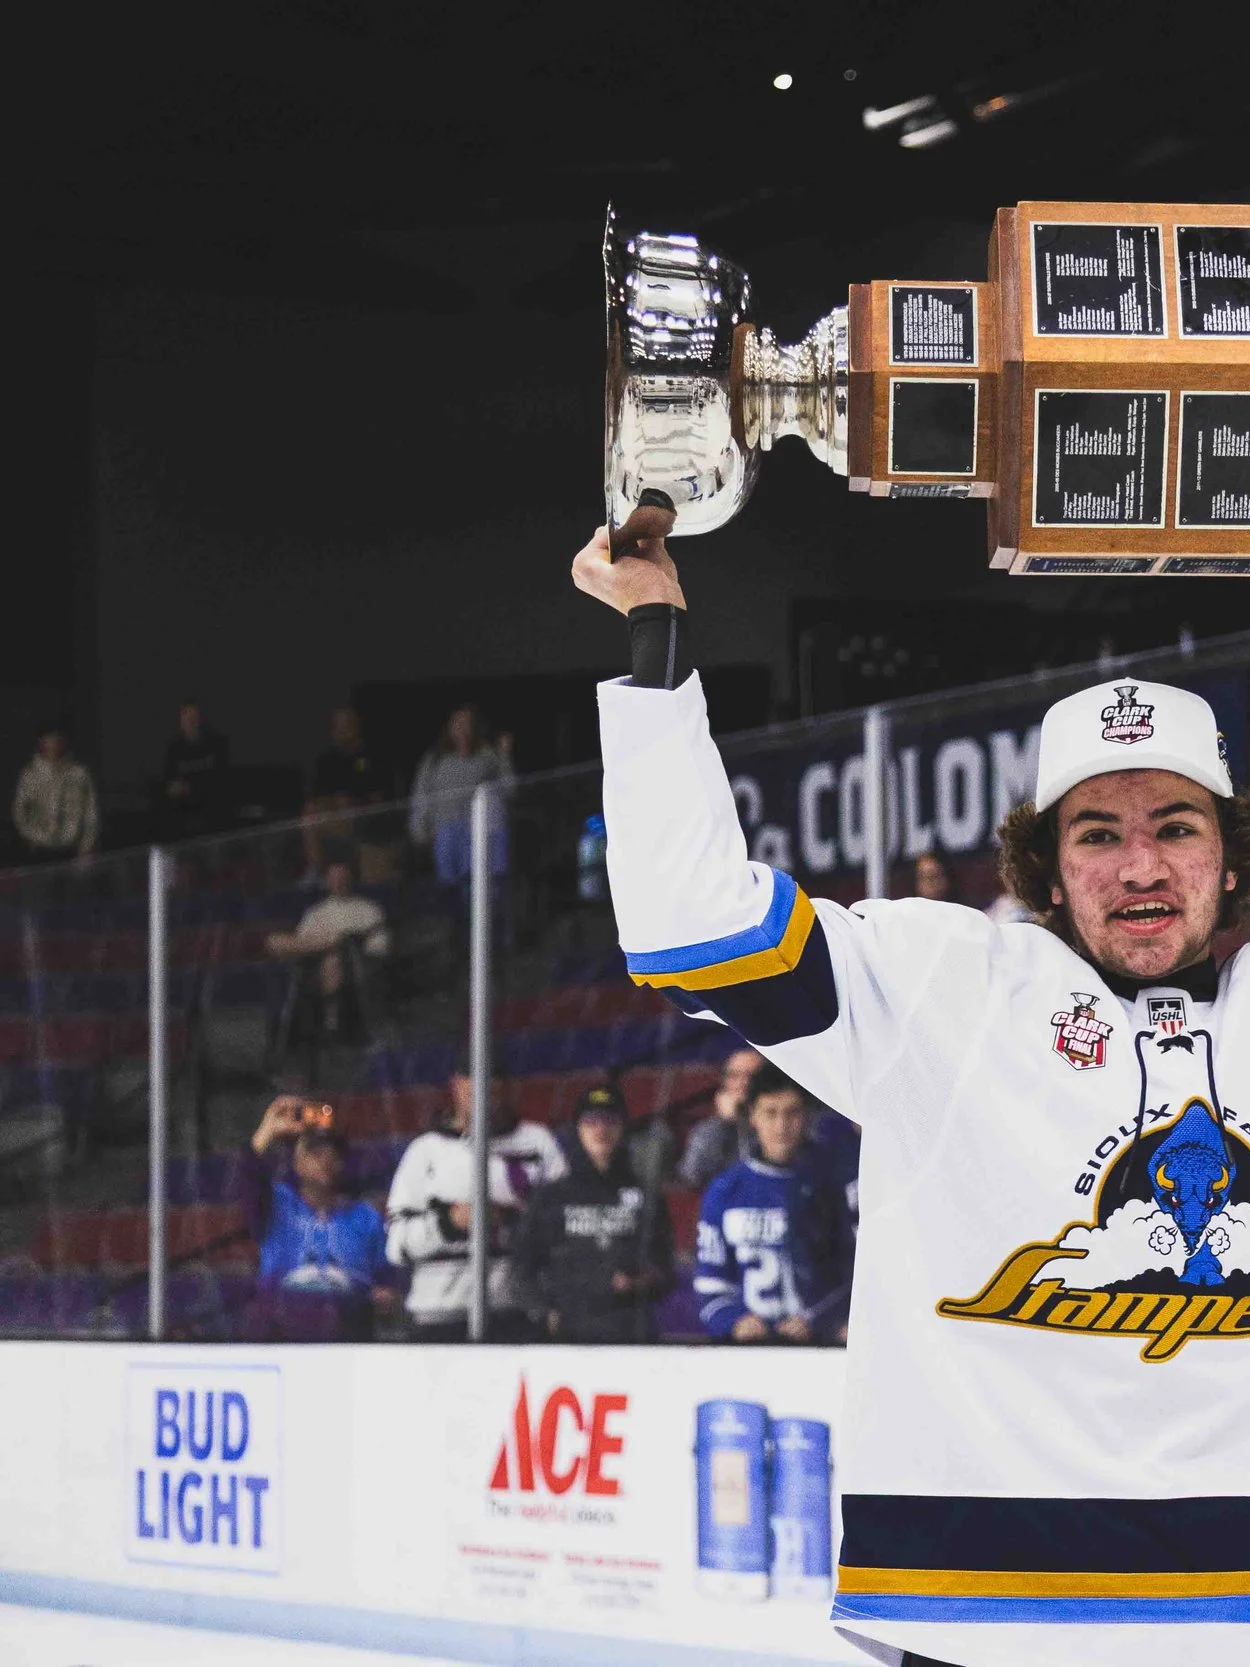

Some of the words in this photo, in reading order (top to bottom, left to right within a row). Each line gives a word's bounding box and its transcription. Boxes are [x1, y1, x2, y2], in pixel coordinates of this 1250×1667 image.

[1103, 706, 1151, 719] CLARK
[1112, 715, 1142, 727] CUP
[1103, 725, 1152, 738] CHAMPIONS
[1051, 1011, 1113, 1037] CLARK
[1152, 1011, 1182, 1021] USHL
[1062, 1025, 1100, 1044] CUP
[1068, 1039, 1093, 1055] FINAL
[1074, 1103, 1174, 1196] SIOUX
[156, 1389, 249, 1462] BUD
[489, 1374, 628, 1496] ACE
[136, 1468, 269, 1548] LIGHT
